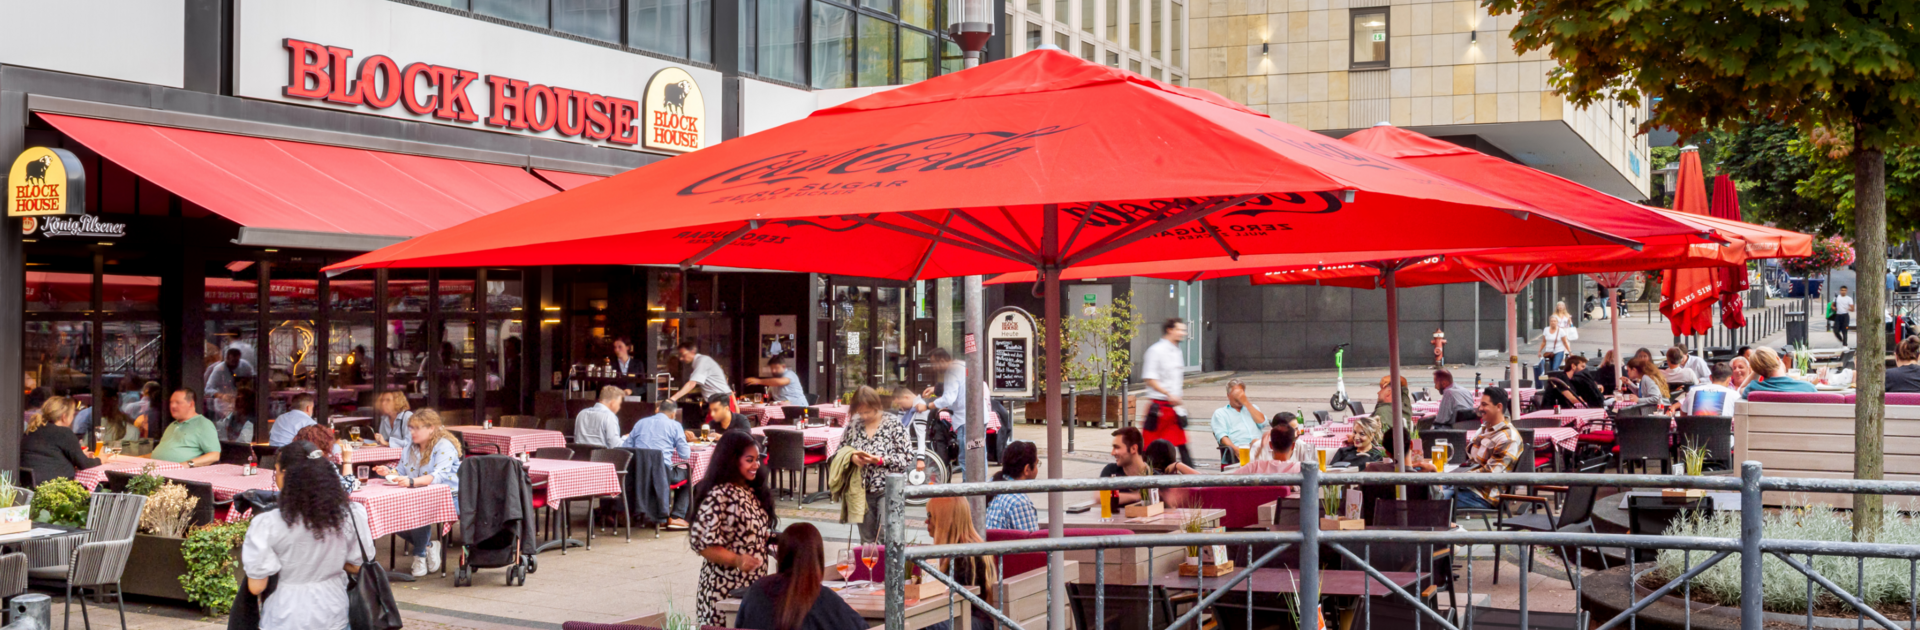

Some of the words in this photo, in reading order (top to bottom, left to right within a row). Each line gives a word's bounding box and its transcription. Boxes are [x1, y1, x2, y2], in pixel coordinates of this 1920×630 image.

[282, 37, 479, 123] BLOCK
[484, 74, 639, 146] HOUSE
[653, 110, 698, 132] BLOCK
[653, 130, 699, 149] HOUSE
[16, 184, 59, 198] BLOCK
[708, 187, 791, 204] ZERO
[796, 179, 909, 192] SUGAR
[15, 198, 59, 212] HOUSE
[40, 216, 80, 235] König
[77, 214, 127, 234] Pilsener
[1672, 293, 1696, 310] TEAKS
